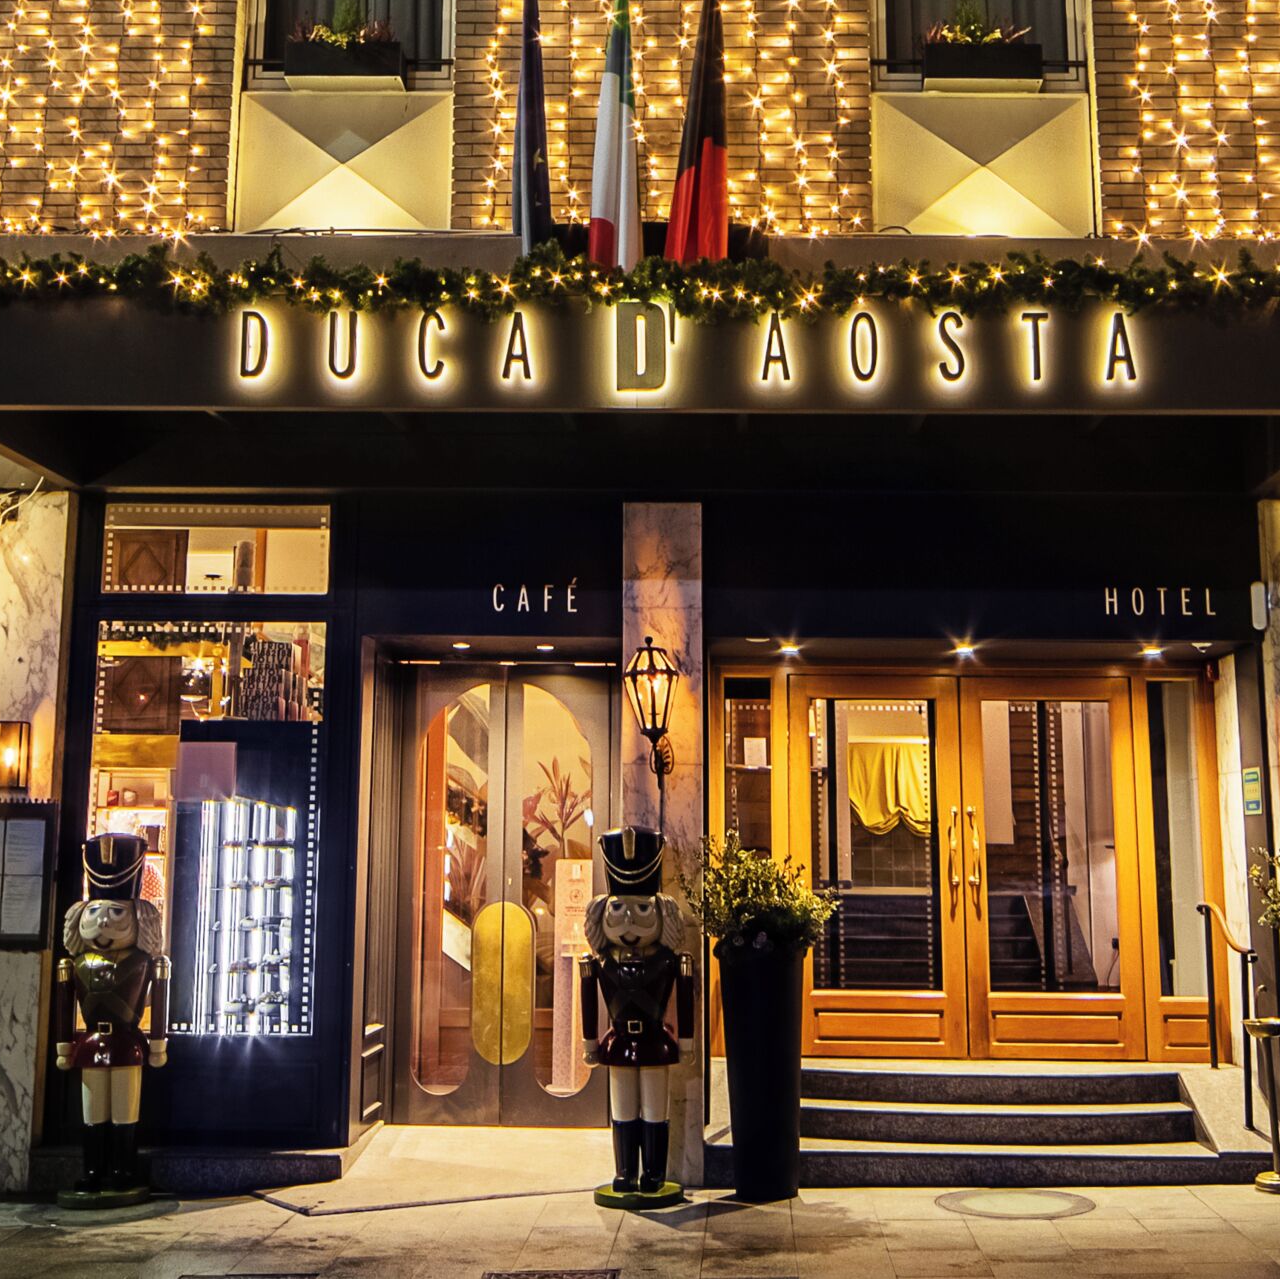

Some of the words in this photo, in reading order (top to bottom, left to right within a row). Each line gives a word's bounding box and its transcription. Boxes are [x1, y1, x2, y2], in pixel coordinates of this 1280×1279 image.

[239, 310, 532, 380] DUCA
[492, 577, 578, 612] CAFÉ
[1104, 587, 1217, 616] HOTEL
